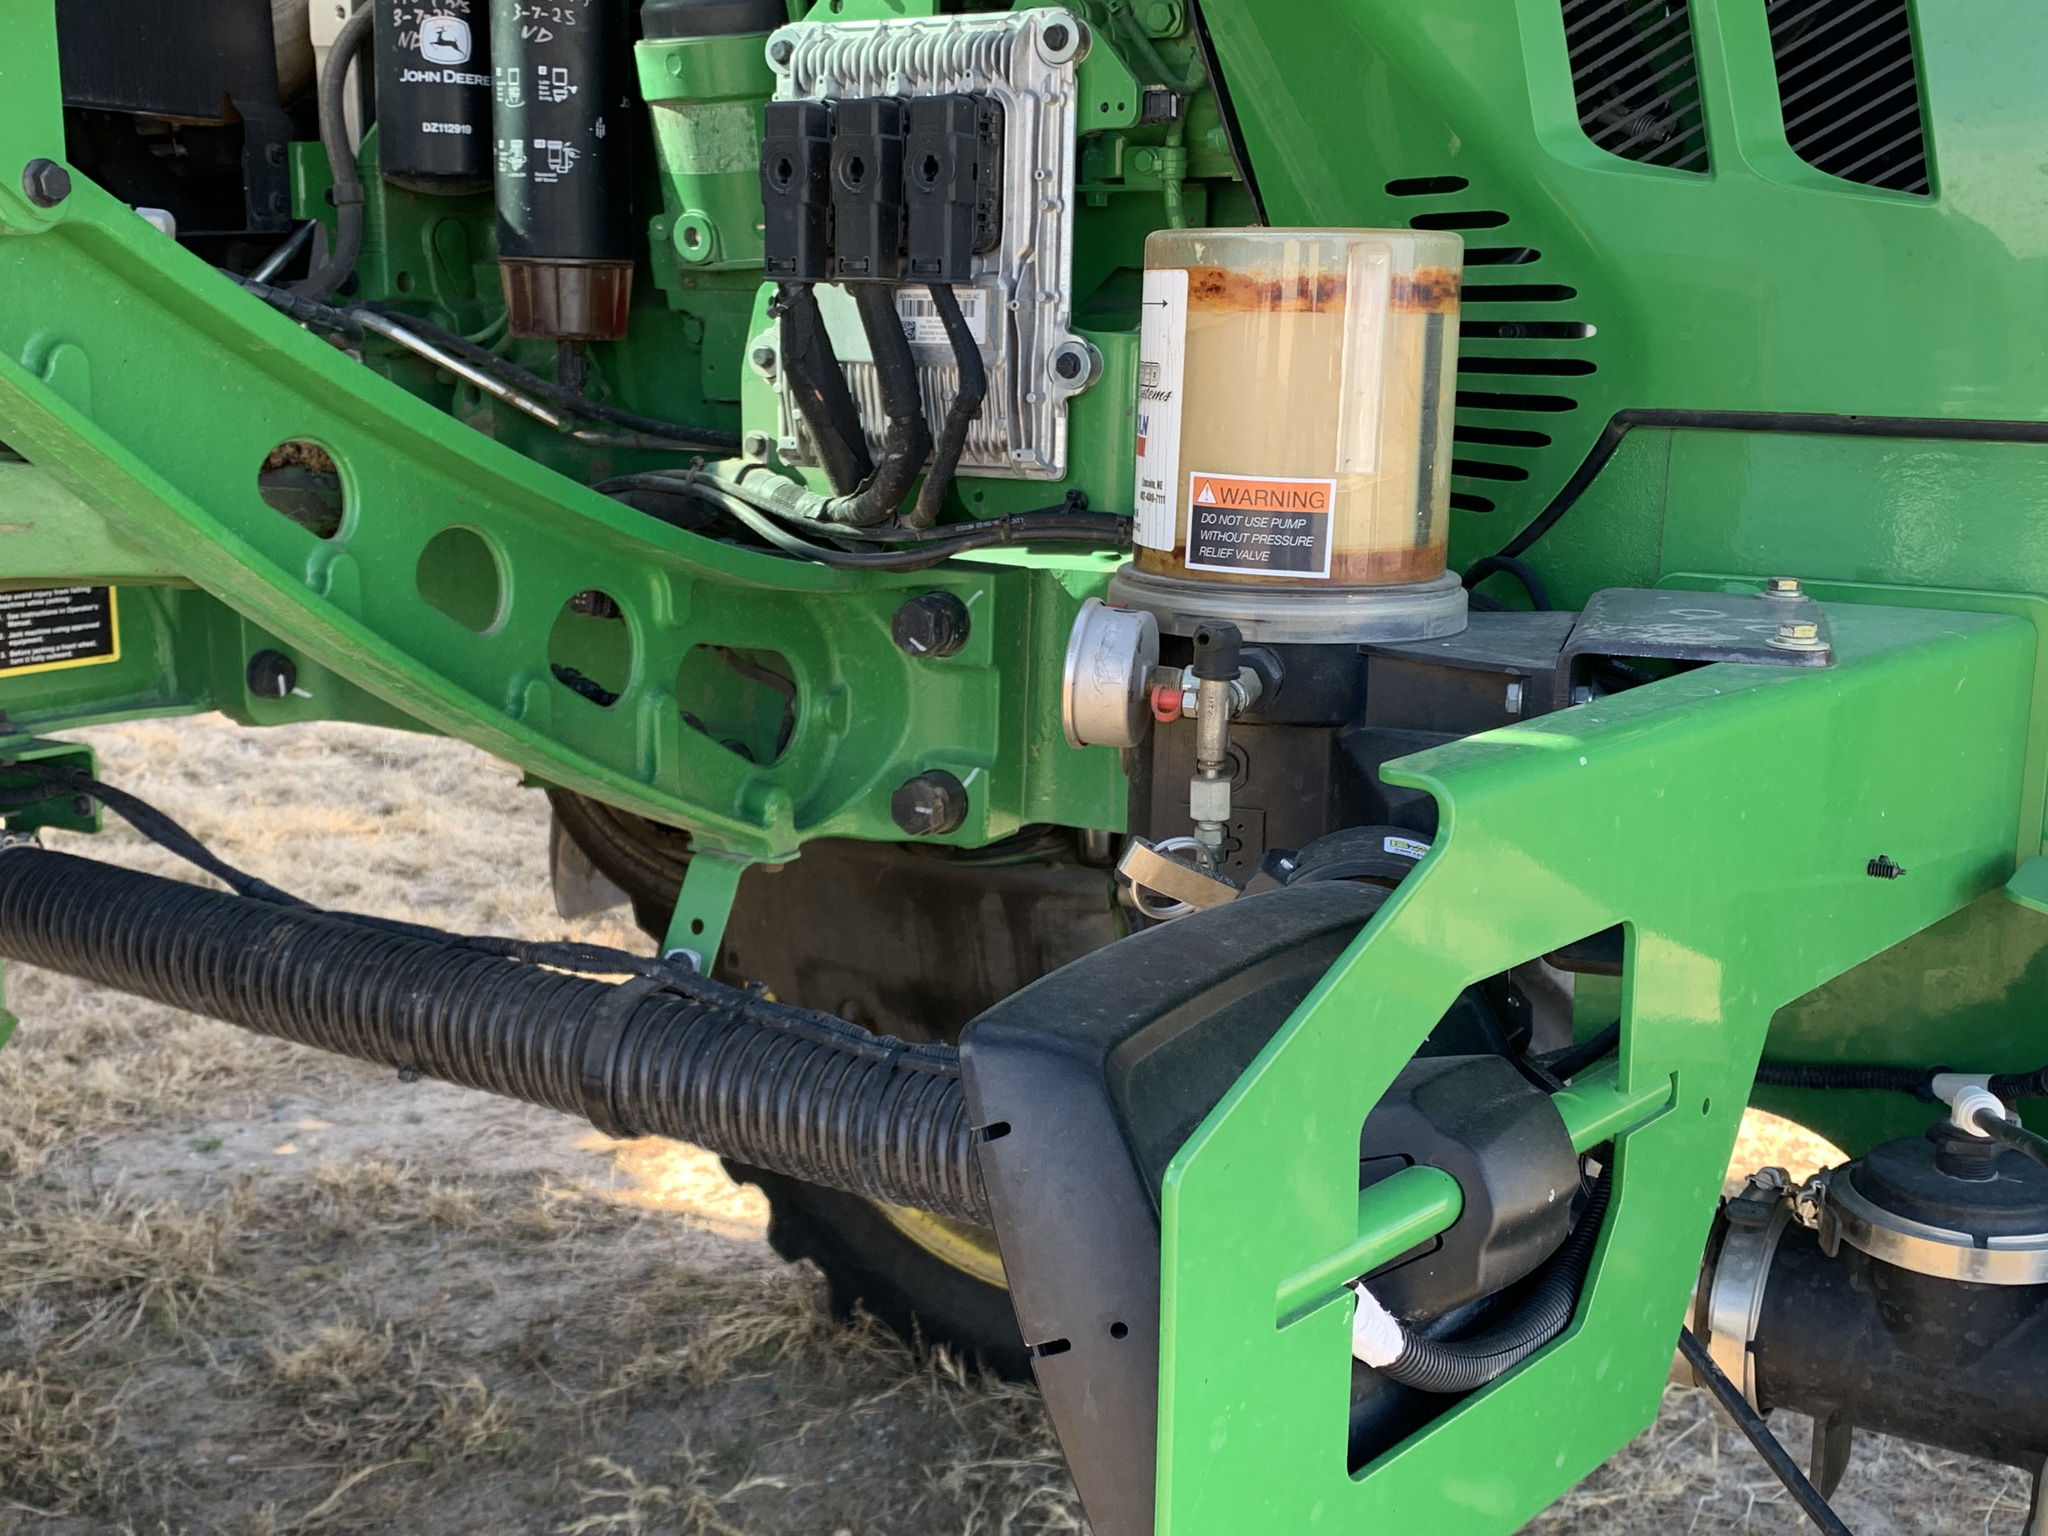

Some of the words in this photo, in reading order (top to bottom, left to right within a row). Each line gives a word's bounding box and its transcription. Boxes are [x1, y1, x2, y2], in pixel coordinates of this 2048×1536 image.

[512, 3, 576, 26] 3-7-25
[399, 68, 441, 83] JOHN
[443, 69, 491, 87] DEERE
[422, 122, 472, 135] DZ112919
[1220, 486, 1325, 509] WARNING
[1200, 513, 1217, 524] DO
[1218, 514, 1243, 526] NOT
[1244, 516, 1269, 528] USE
[1270, 517, 1307, 530] PUMP
[1200, 529, 1250, 543] WITHOUT
[1251, 536, 1314, 547] PRESSURE
[1199, 546, 1235, 559] RELIEF
[1235, 549, 1270, 561] VALVE
[13, 592, 32, 600] avoid
[33, 591, 53, 599] injury
[7, 612, 20, 620] See
[20, 609, 58, 619] instructions
[66, 604, 99, 614] Operator's
[8, 631, 24, 639] Jack
[24, 628, 52, 637] machine
[52, 625, 71, 634] using
[71, 621, 100, 631] approved
[9, 649, 31, 658] Before
[32, 646, 56, 656] jacking
